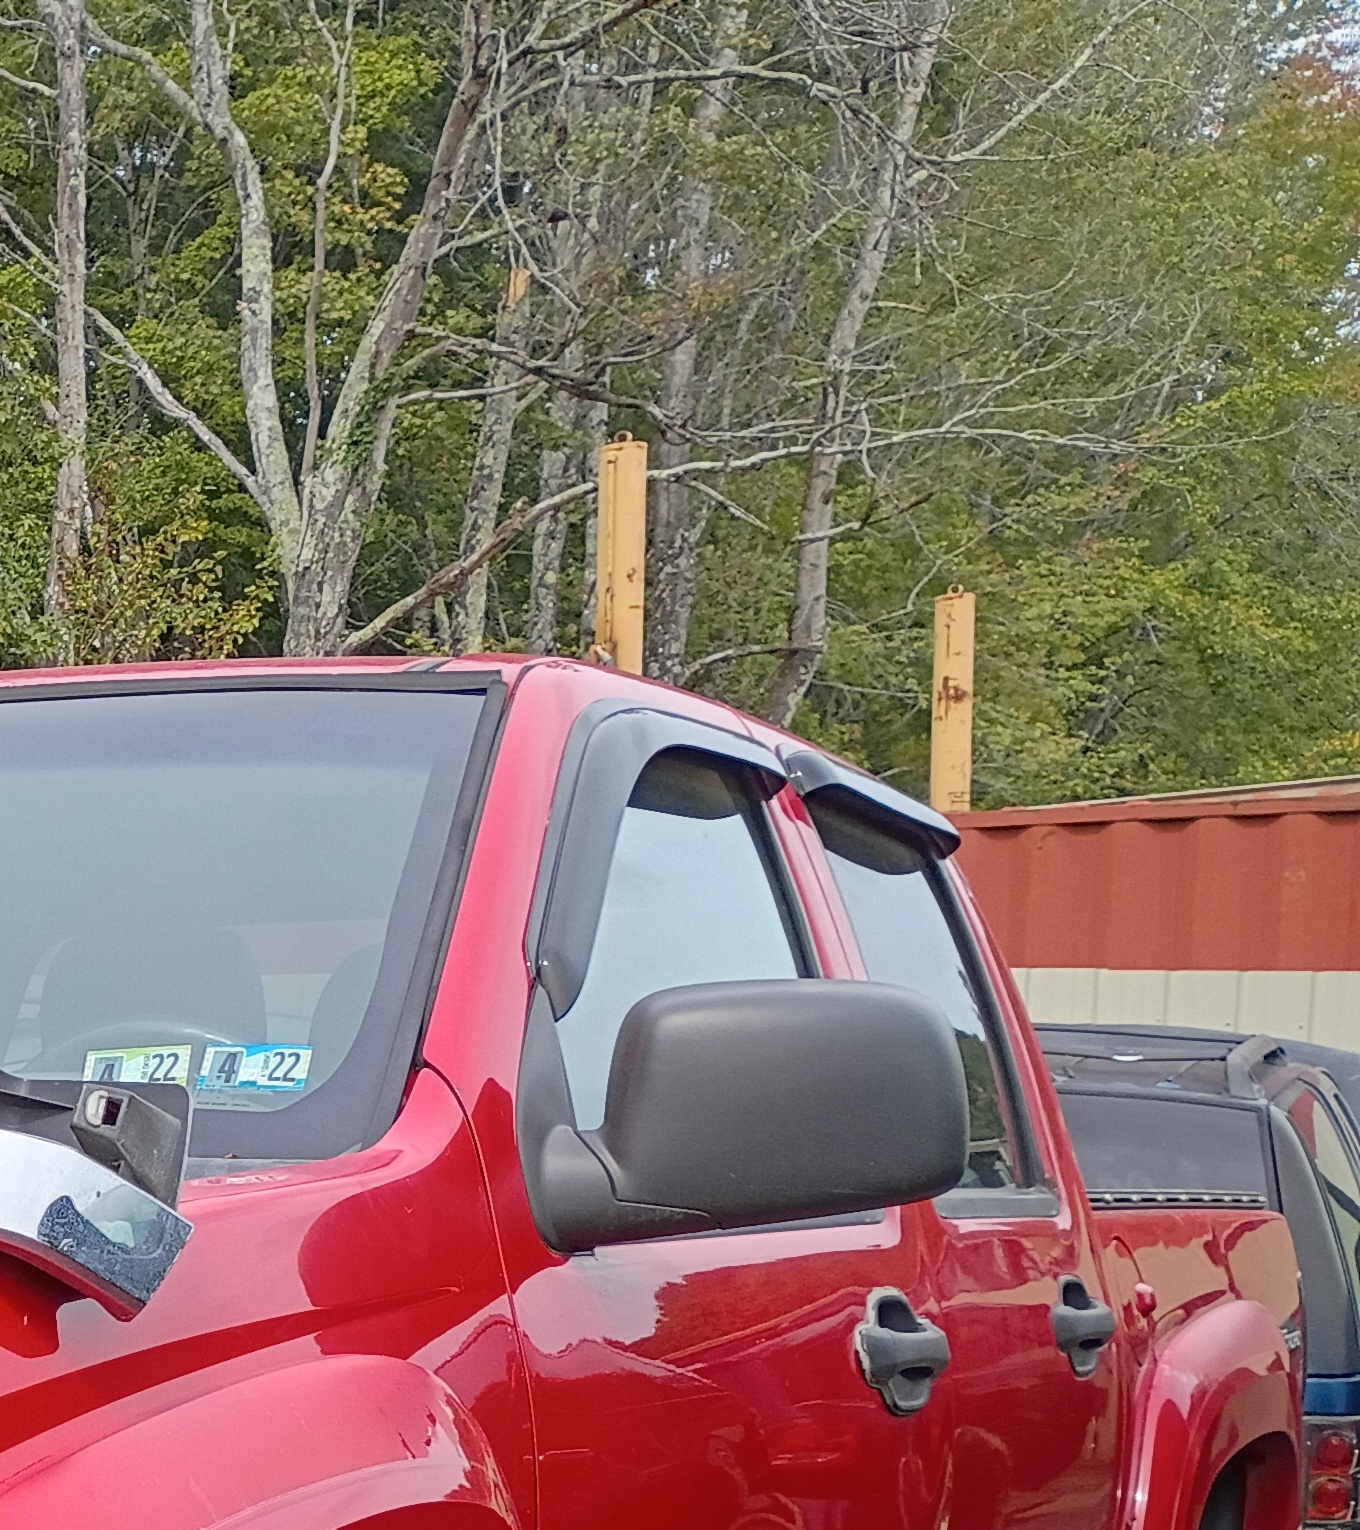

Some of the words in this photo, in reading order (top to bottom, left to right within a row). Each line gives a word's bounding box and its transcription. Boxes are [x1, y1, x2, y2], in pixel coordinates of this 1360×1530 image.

[148, 1052, 180, 1083] 22
[217, 1052, 238, 1084] 4
[266, 1051, 302, 1083] 22
